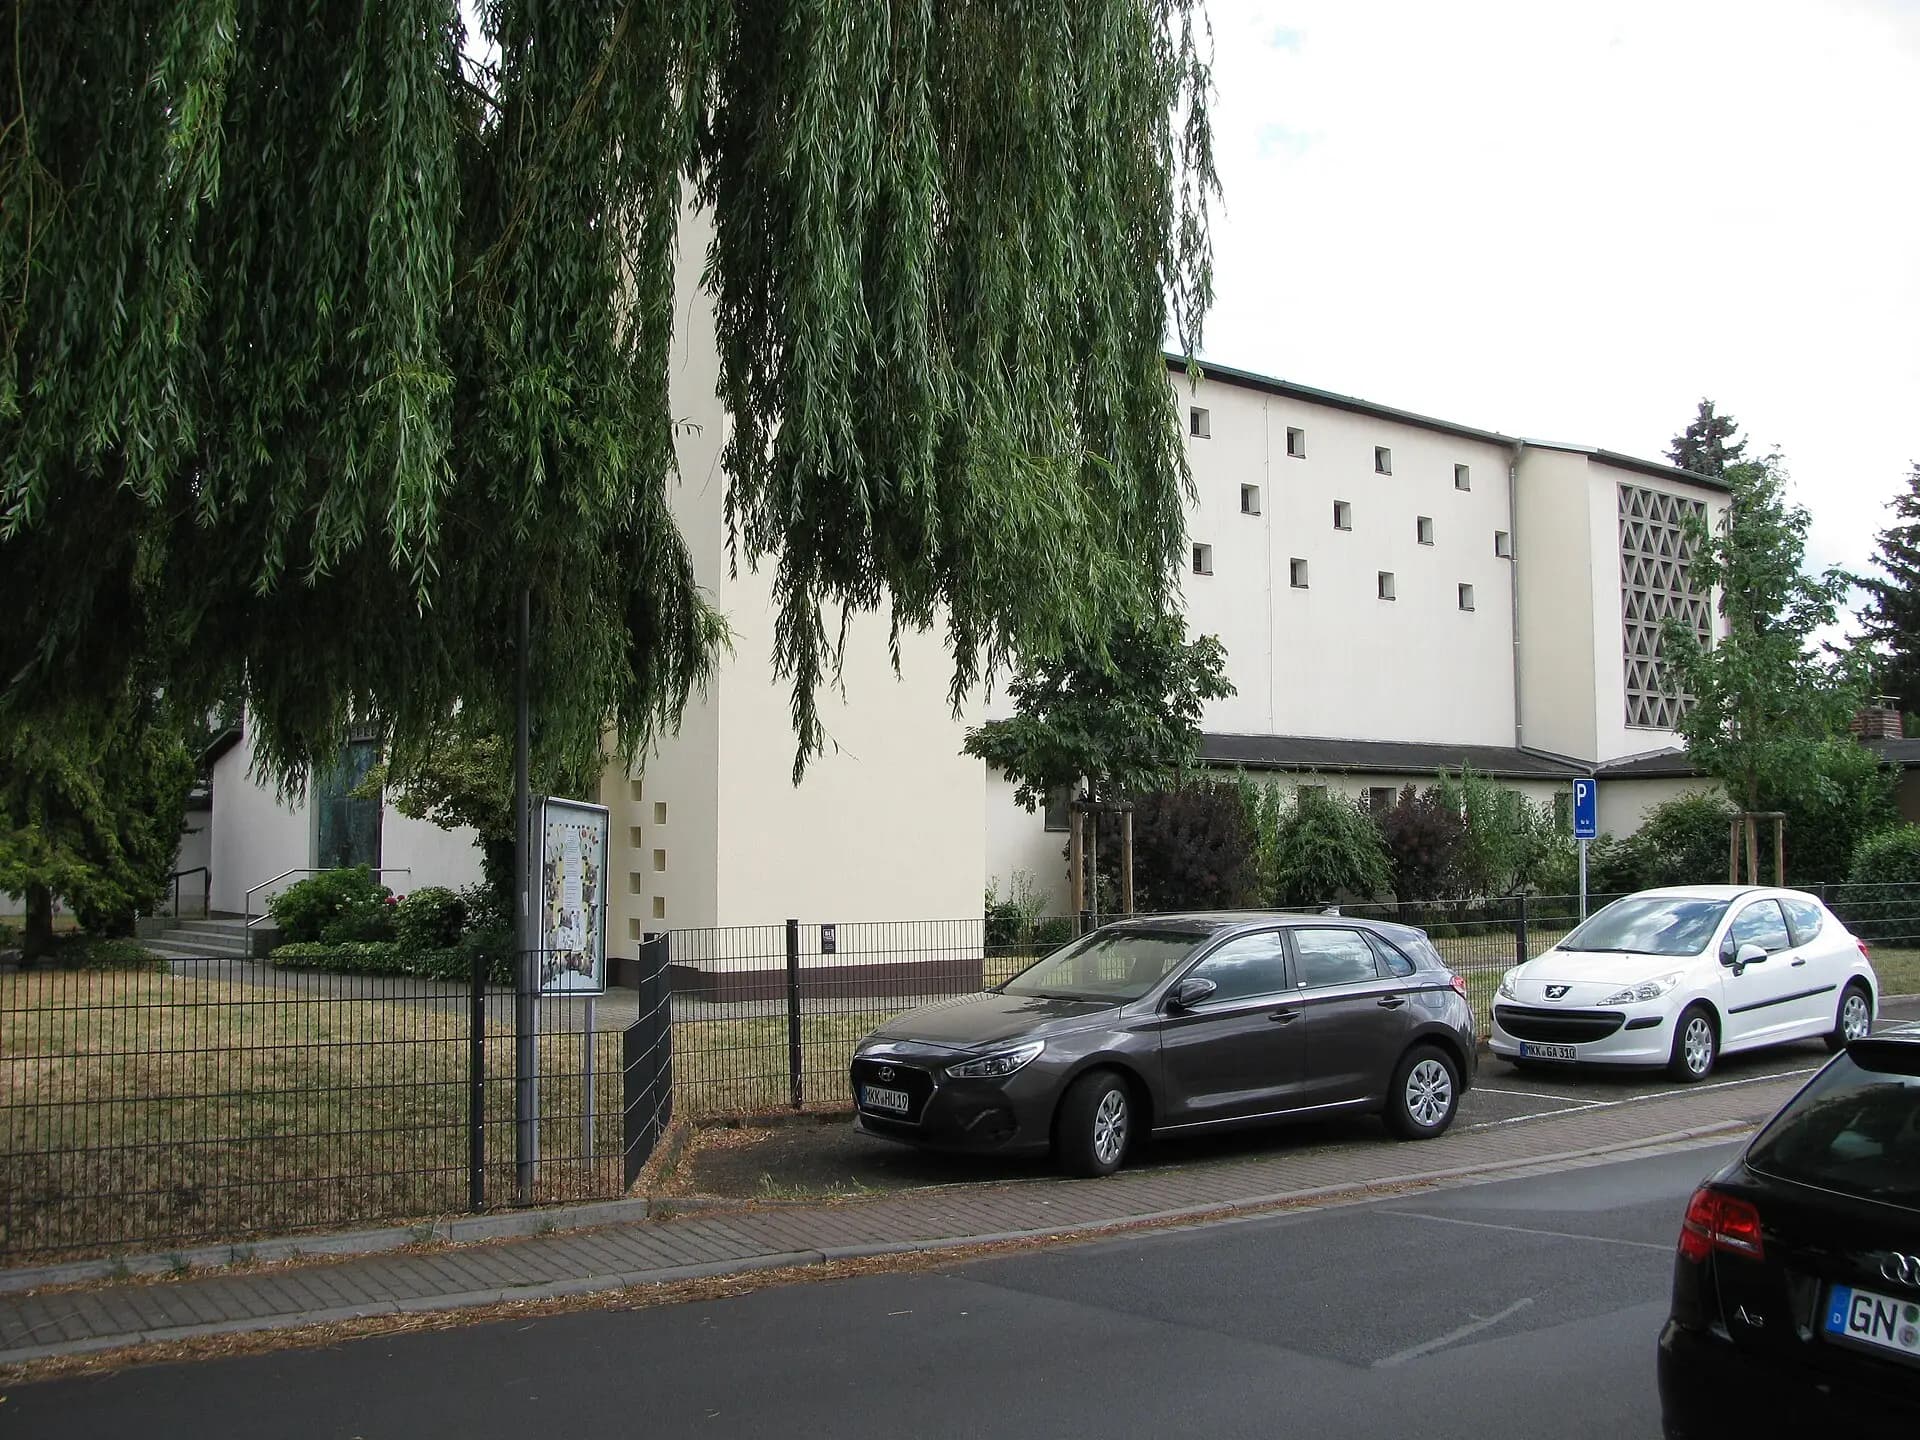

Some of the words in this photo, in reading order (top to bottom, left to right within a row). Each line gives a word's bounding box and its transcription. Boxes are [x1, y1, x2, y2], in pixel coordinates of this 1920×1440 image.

[1576, 783, 1587, 807] P
[1526, 1044, 1541, 1057] MKK
[1546, 1046, 1558, 1057] GA
[1559, 1047, 1575, 1059] 310
[884, 1090, 896, 1107] HU
[897, 1093, 908, 1109] 19
[1848, 1294, 1898, 1342] GN
